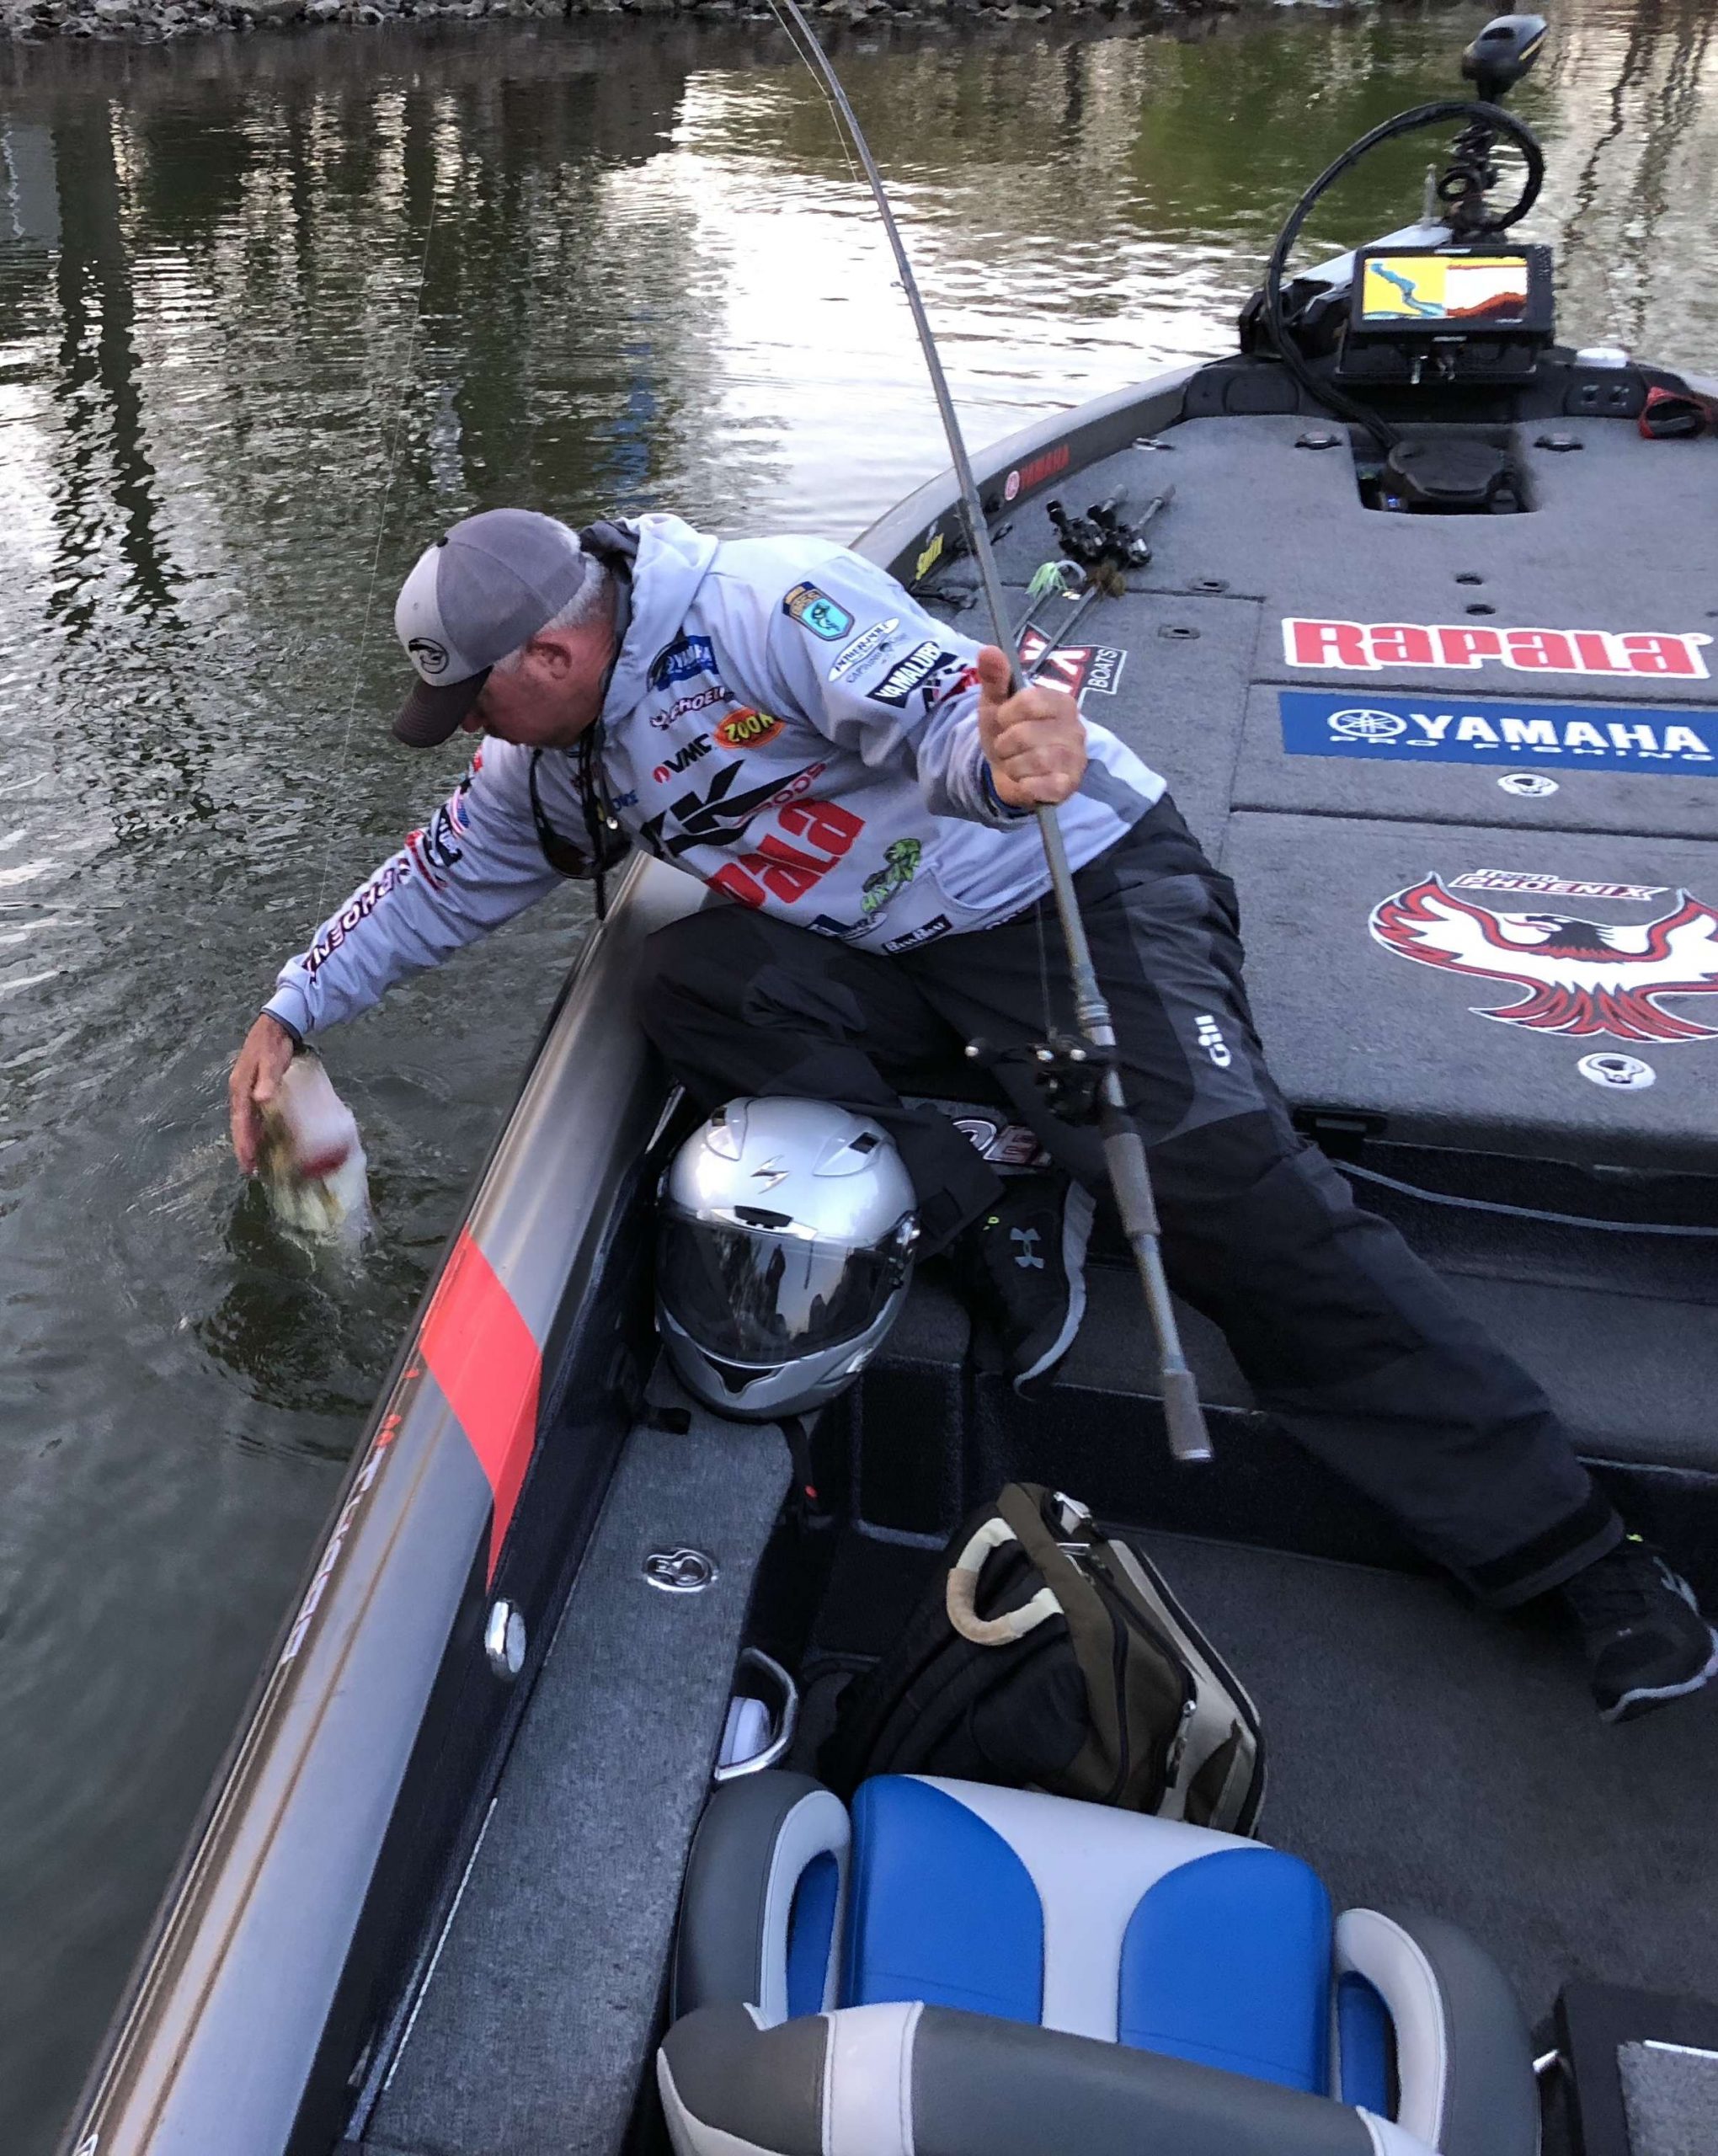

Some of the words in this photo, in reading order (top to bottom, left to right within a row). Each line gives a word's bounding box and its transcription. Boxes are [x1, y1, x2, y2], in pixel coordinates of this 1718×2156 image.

[1087, 648, 1118, 688] BOATS
[1330, 734, 1439, 747] PRO
[1411, 713, 1710, 753] YAMAHA
[663, 733, 712, 774] VMC
[1459, 876, 1648, 898] PHOENIX
[1194, 1015, 1231, 1069] Gill
